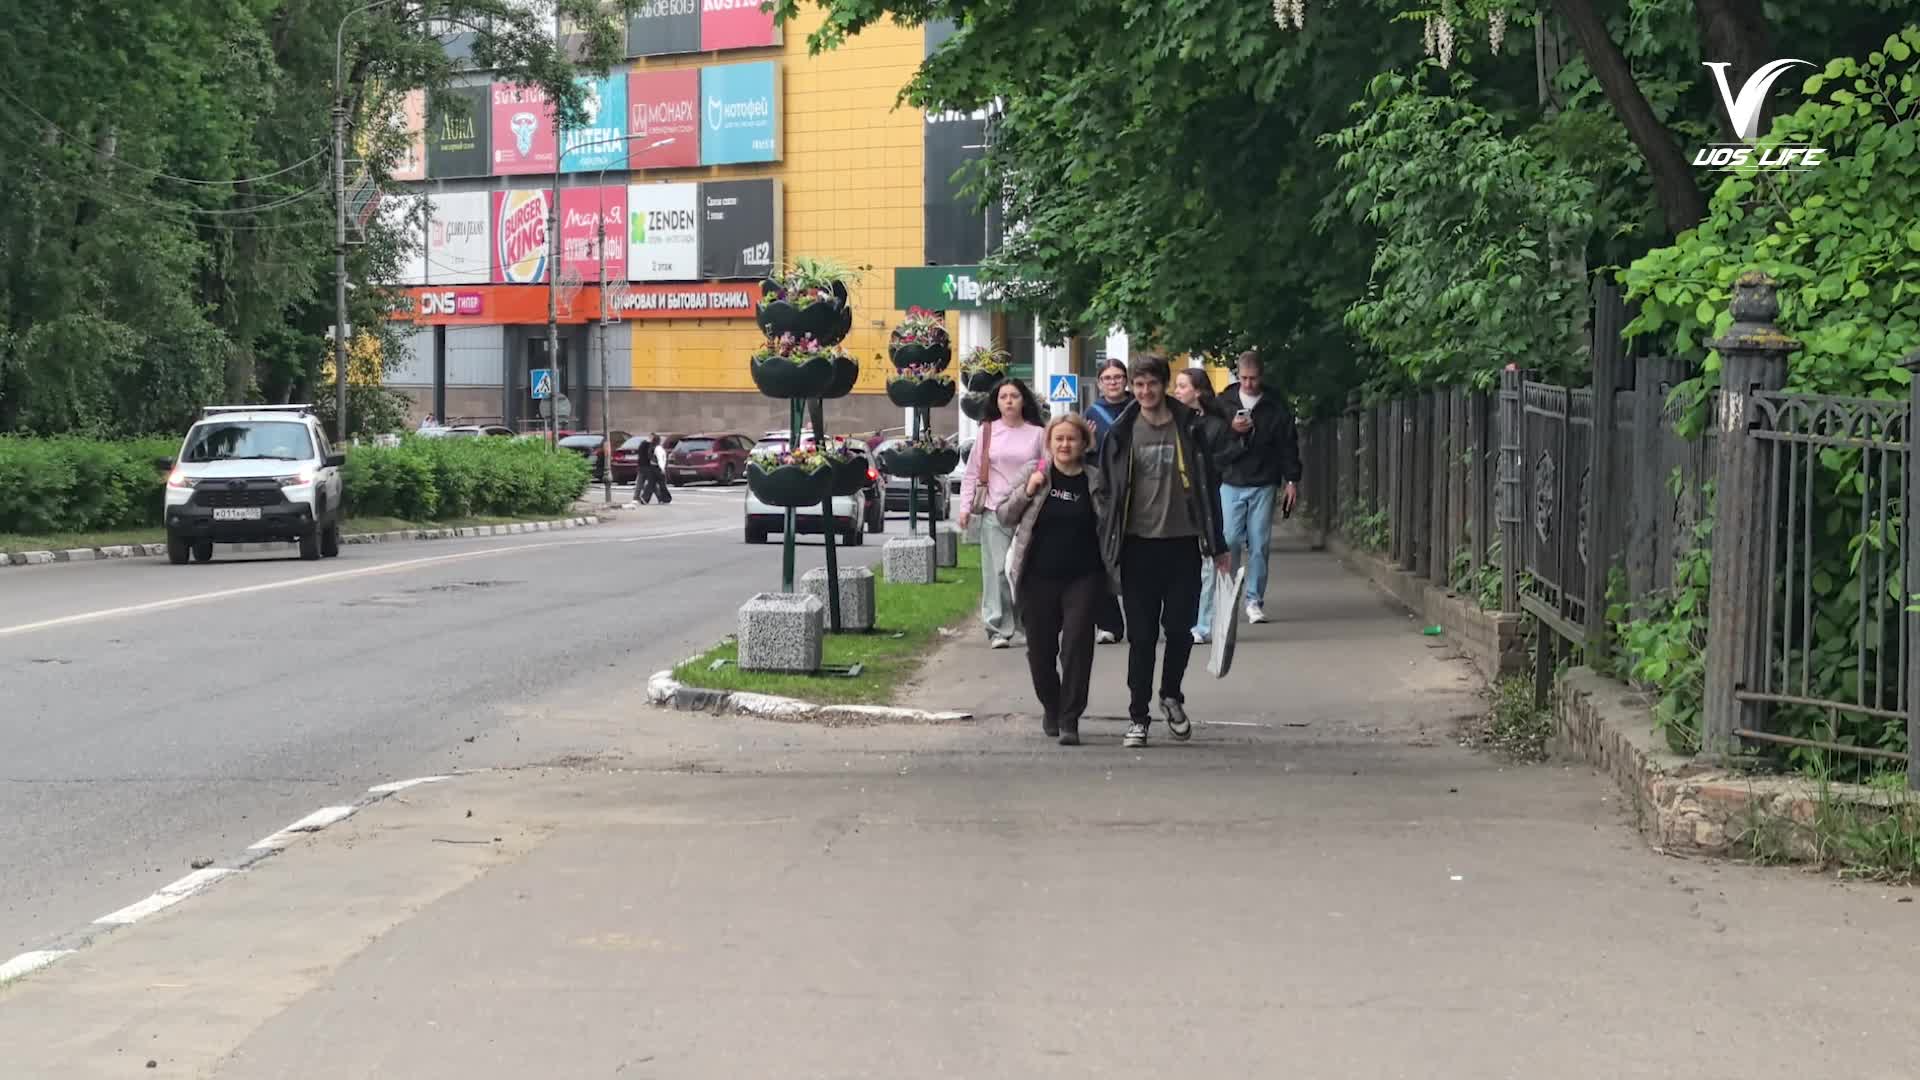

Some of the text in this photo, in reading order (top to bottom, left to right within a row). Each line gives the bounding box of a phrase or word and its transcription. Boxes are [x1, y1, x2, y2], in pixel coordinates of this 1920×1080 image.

[647, 101, 694, 124] МОНАРХ
[722, 97, 769, 121] котофей
[565, 127, 624, 157] АПТЕКА
[504, 197, 543, 242] BURGER
[648, 210, 695, 231] ZENDEN
[506, 218, 545, 265] KING
[743, 241, 771, 267] TELE2
[421, 292, 455, 315] DNS
[659, 294, 666, 310] И
[668, 292, 707, 309] БЫТОВАЯ
[709, 291, 750, 309] ТЕХНИКА
